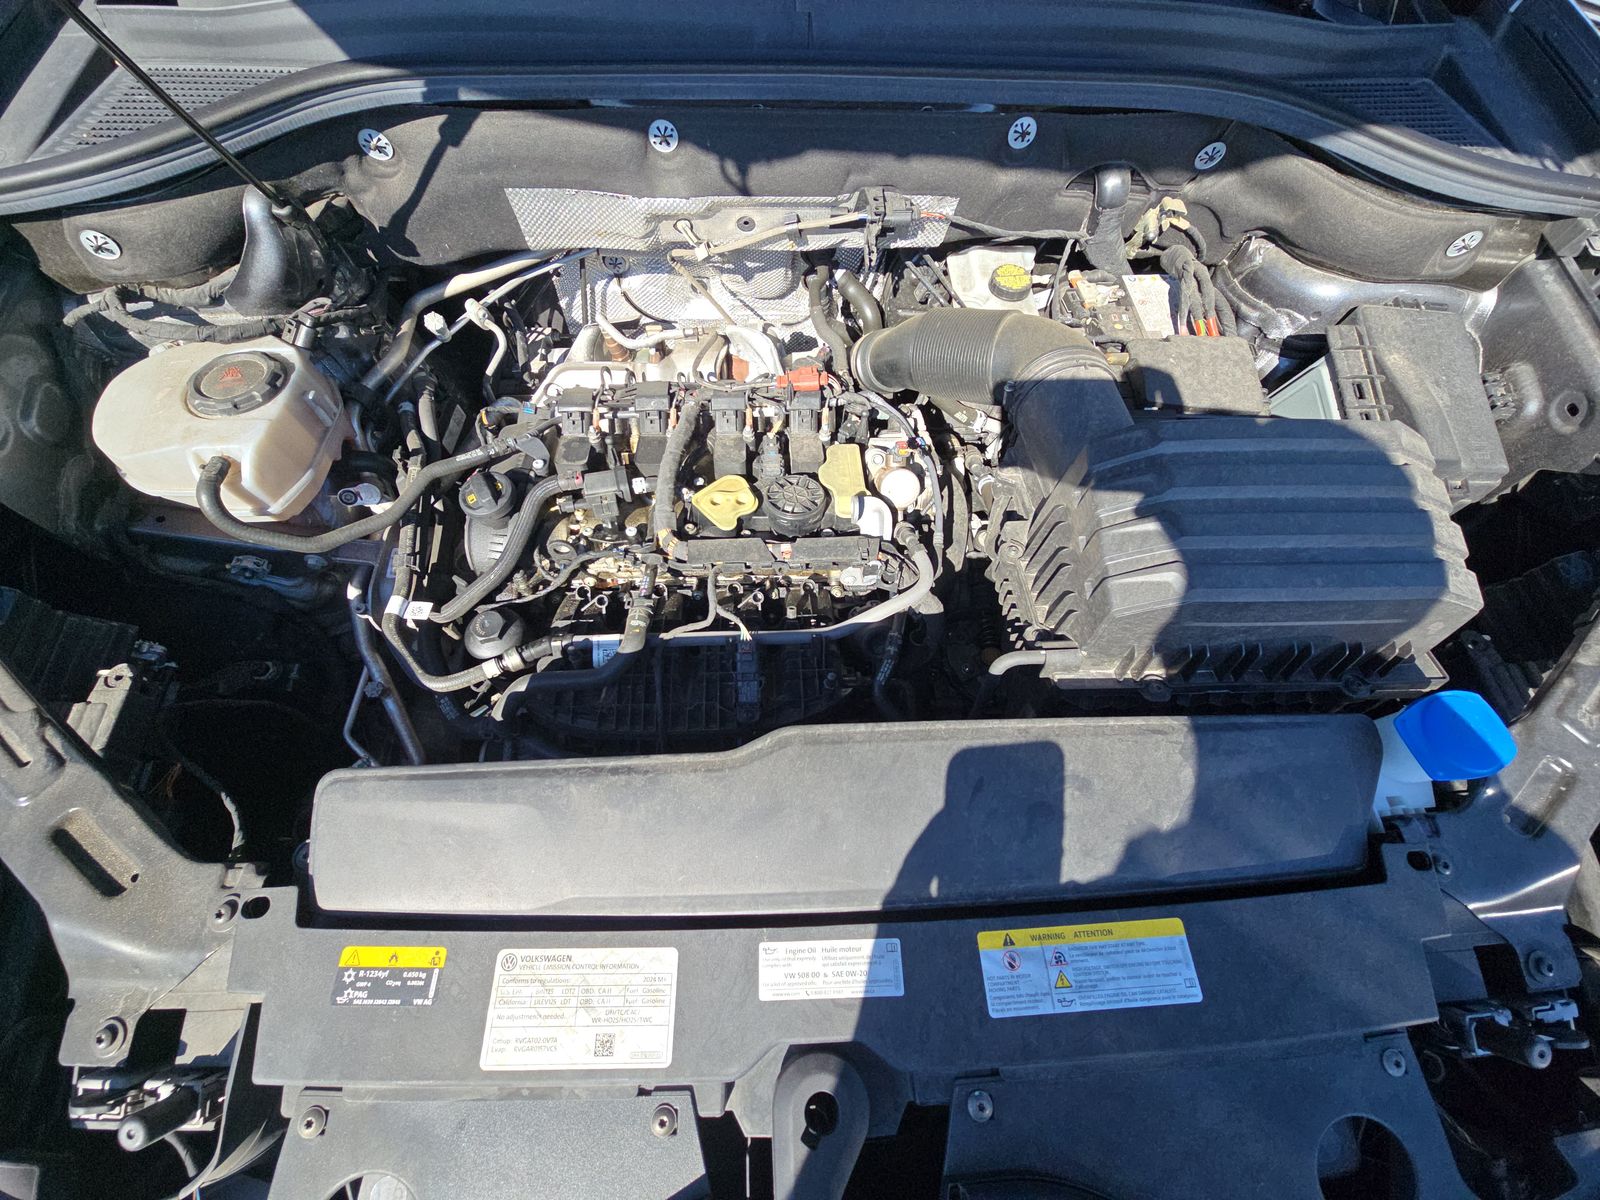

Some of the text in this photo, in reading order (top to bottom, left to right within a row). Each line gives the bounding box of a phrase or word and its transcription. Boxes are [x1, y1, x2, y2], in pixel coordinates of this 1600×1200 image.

[1030, 929, 1114, 942] WARNING ATTENTION
[520, 954, 573, 963] VOLKSWAGEN
[599, 962, 640, 970] INFORMATION
[358, 970, 390, 979] R-1234yf
[797, 971, 810, 979] 508
[831, 970, 844, 978] SAE
[354, 990, 368, 998] PAG
